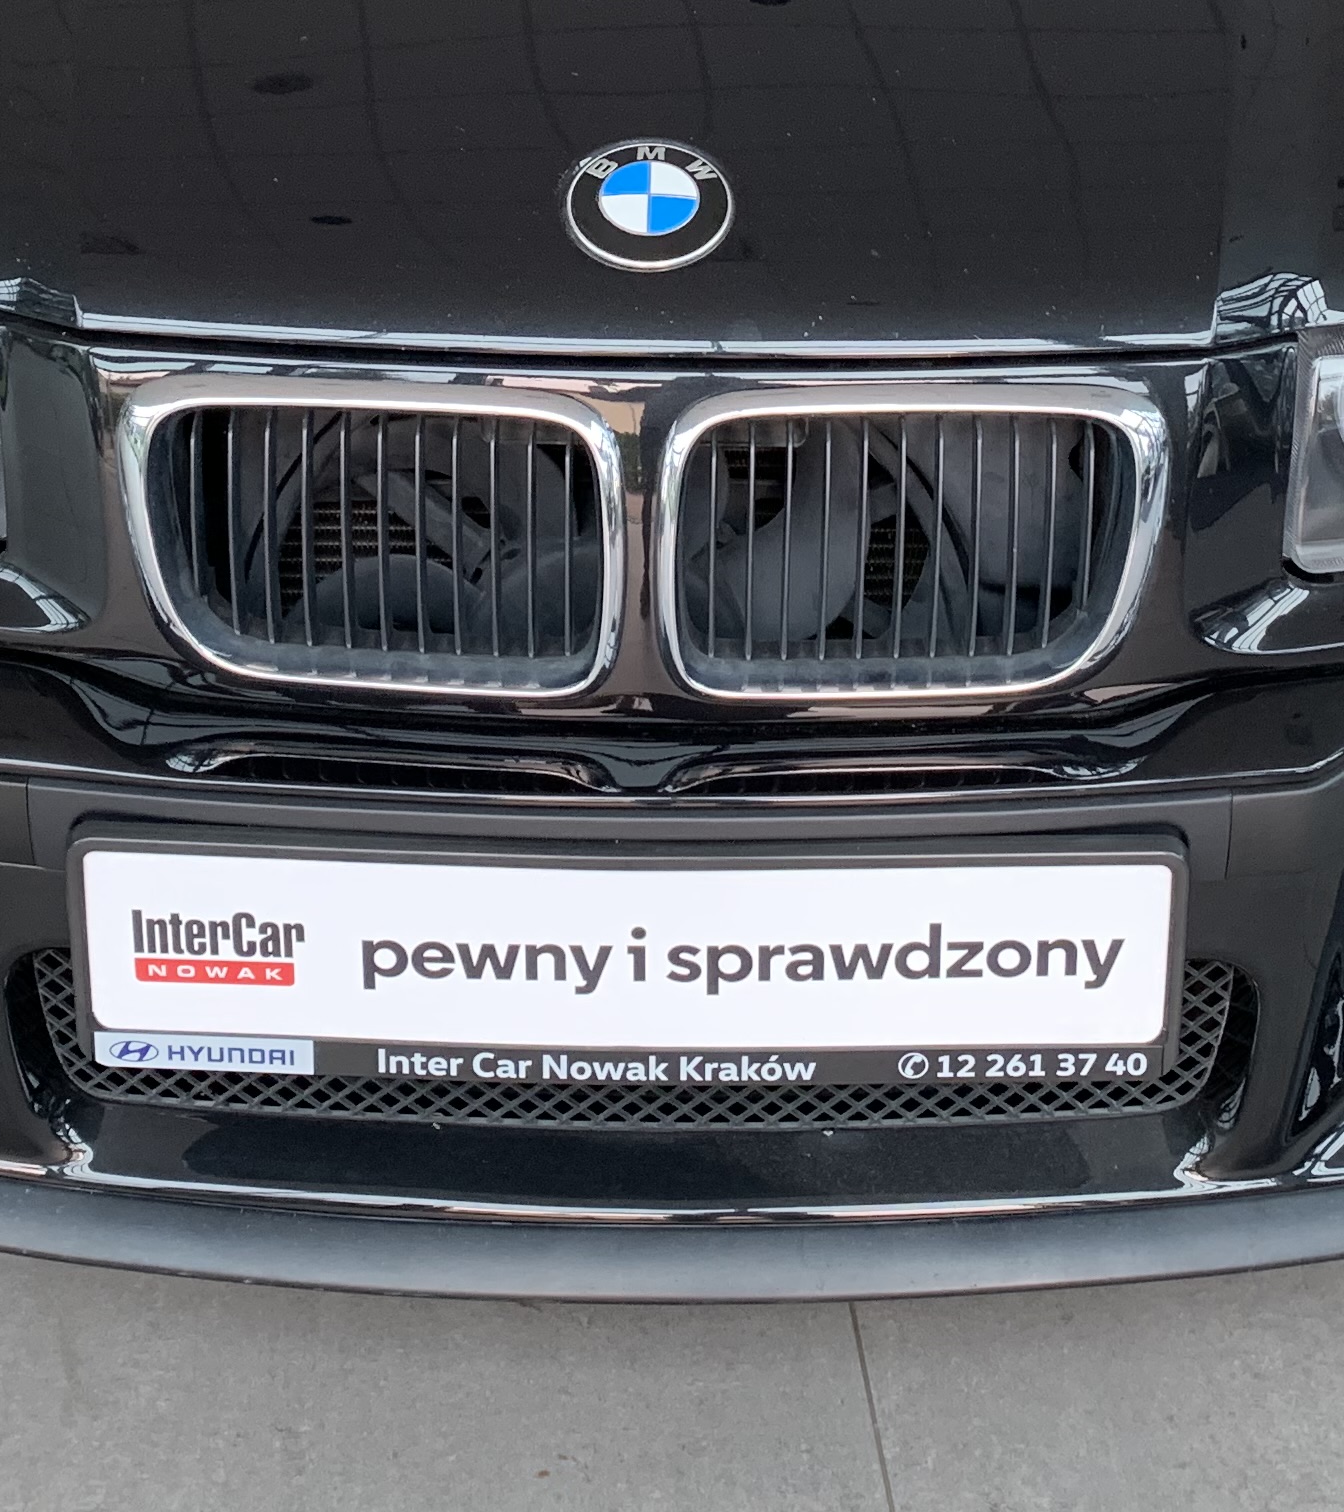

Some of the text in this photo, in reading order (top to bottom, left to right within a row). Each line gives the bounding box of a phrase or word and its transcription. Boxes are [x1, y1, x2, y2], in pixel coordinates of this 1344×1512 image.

[587, 146, 718, 180] BMW
[131, 909, 305, 958] InterCar
[148, 964, 283, 980] NOWAK
[362, 923, 1126, 996] pewny i sprawdzony
[167, 1045, 295, 1066] HYUNDAI
[377, 1048, 1148, 1082] Inter Car Nowak Kraków 12 261 37 40
